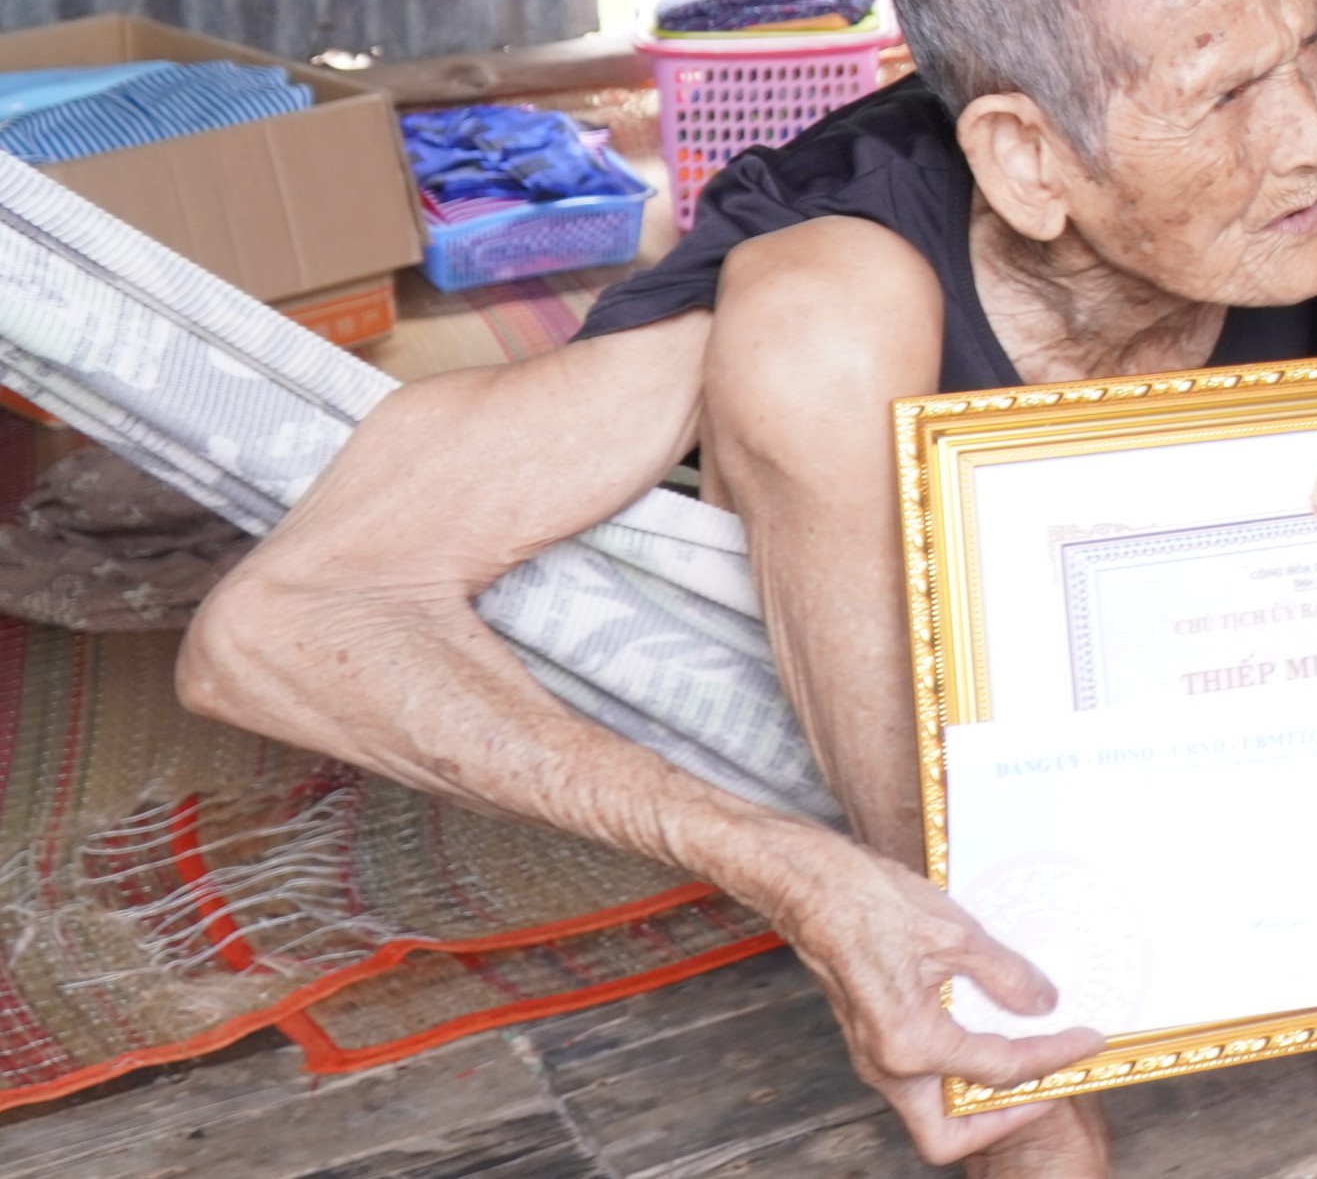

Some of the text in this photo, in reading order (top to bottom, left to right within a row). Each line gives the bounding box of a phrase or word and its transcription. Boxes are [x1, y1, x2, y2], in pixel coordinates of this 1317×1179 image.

[1172, 611, 1214, 636] CHỦ
[1219, 608, 1266, 633] TỊCH
[1270, 599, 1297, 624] ỦY
[1179, 652, 1277, 697] THIẾP
